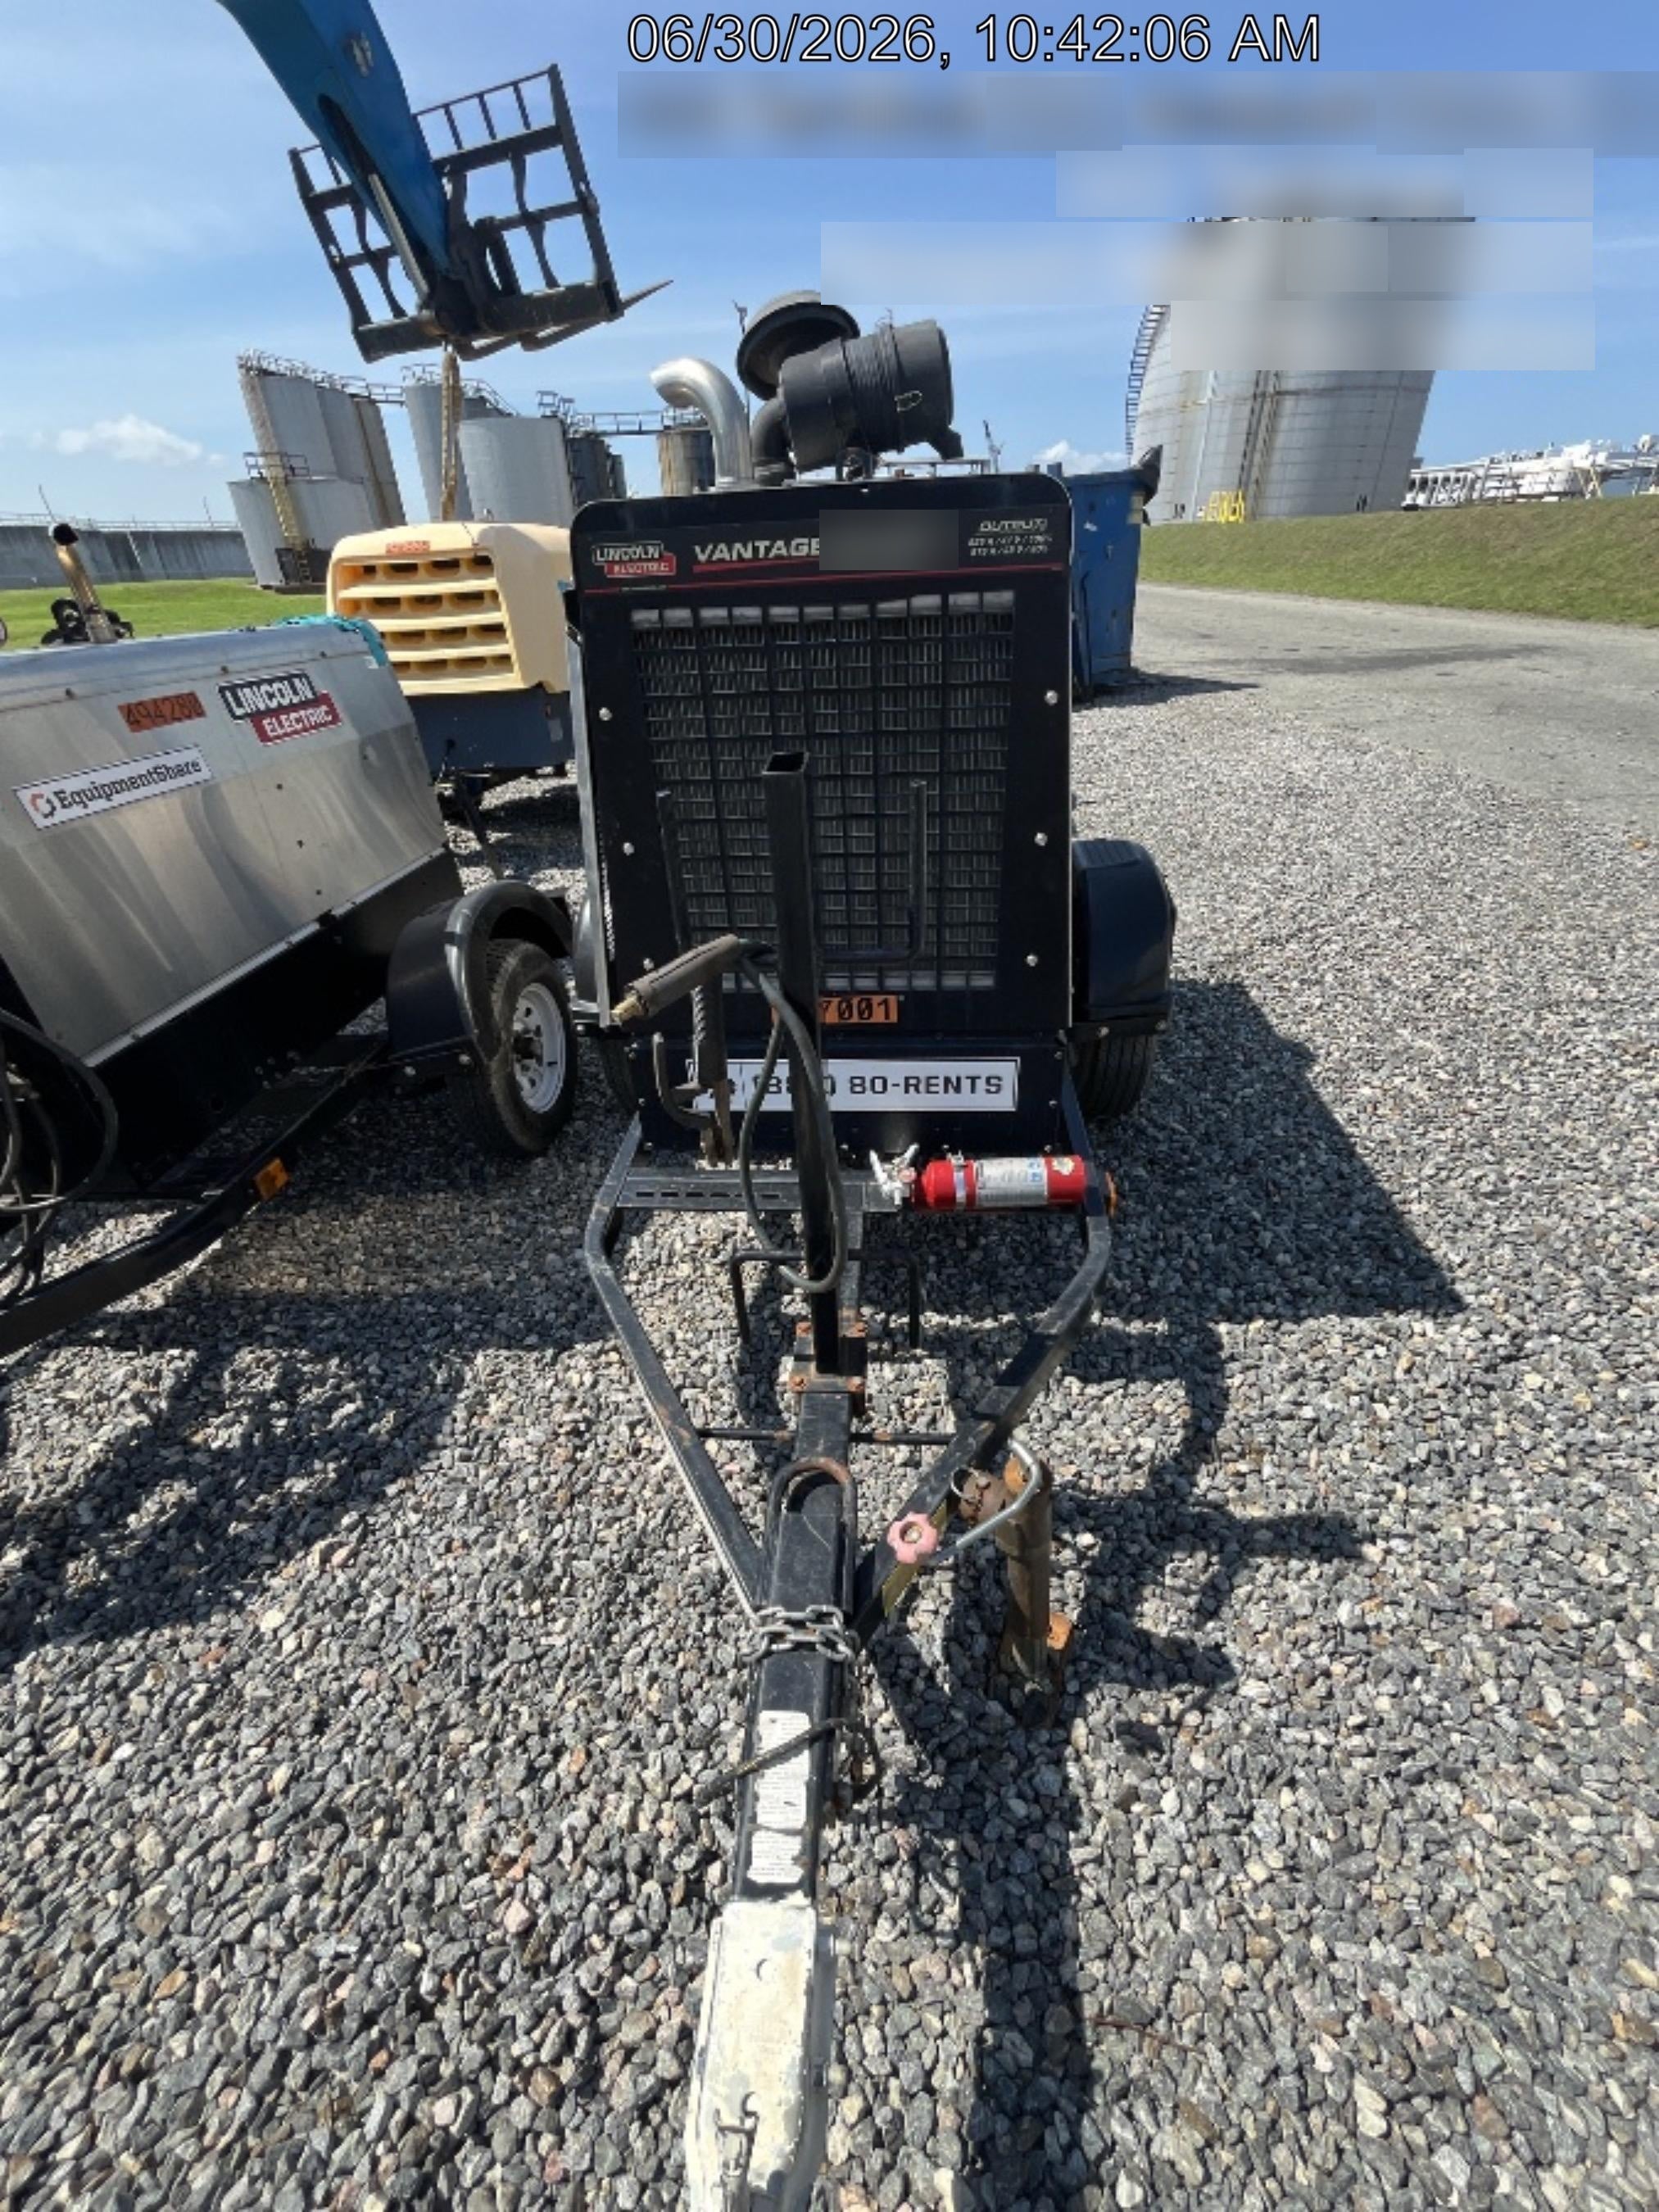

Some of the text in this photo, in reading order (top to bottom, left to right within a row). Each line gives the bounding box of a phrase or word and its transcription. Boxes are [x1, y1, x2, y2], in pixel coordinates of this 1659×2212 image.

[596, 545, 660, 562] LINCOLN
[614, 561, 670, 573] ELECTRIC
[224, 677, 316, 716] LINCOLN
[261, 705, 333, 737] ELECTRIC
[53, 759, 203, 810] EquipmentShare
